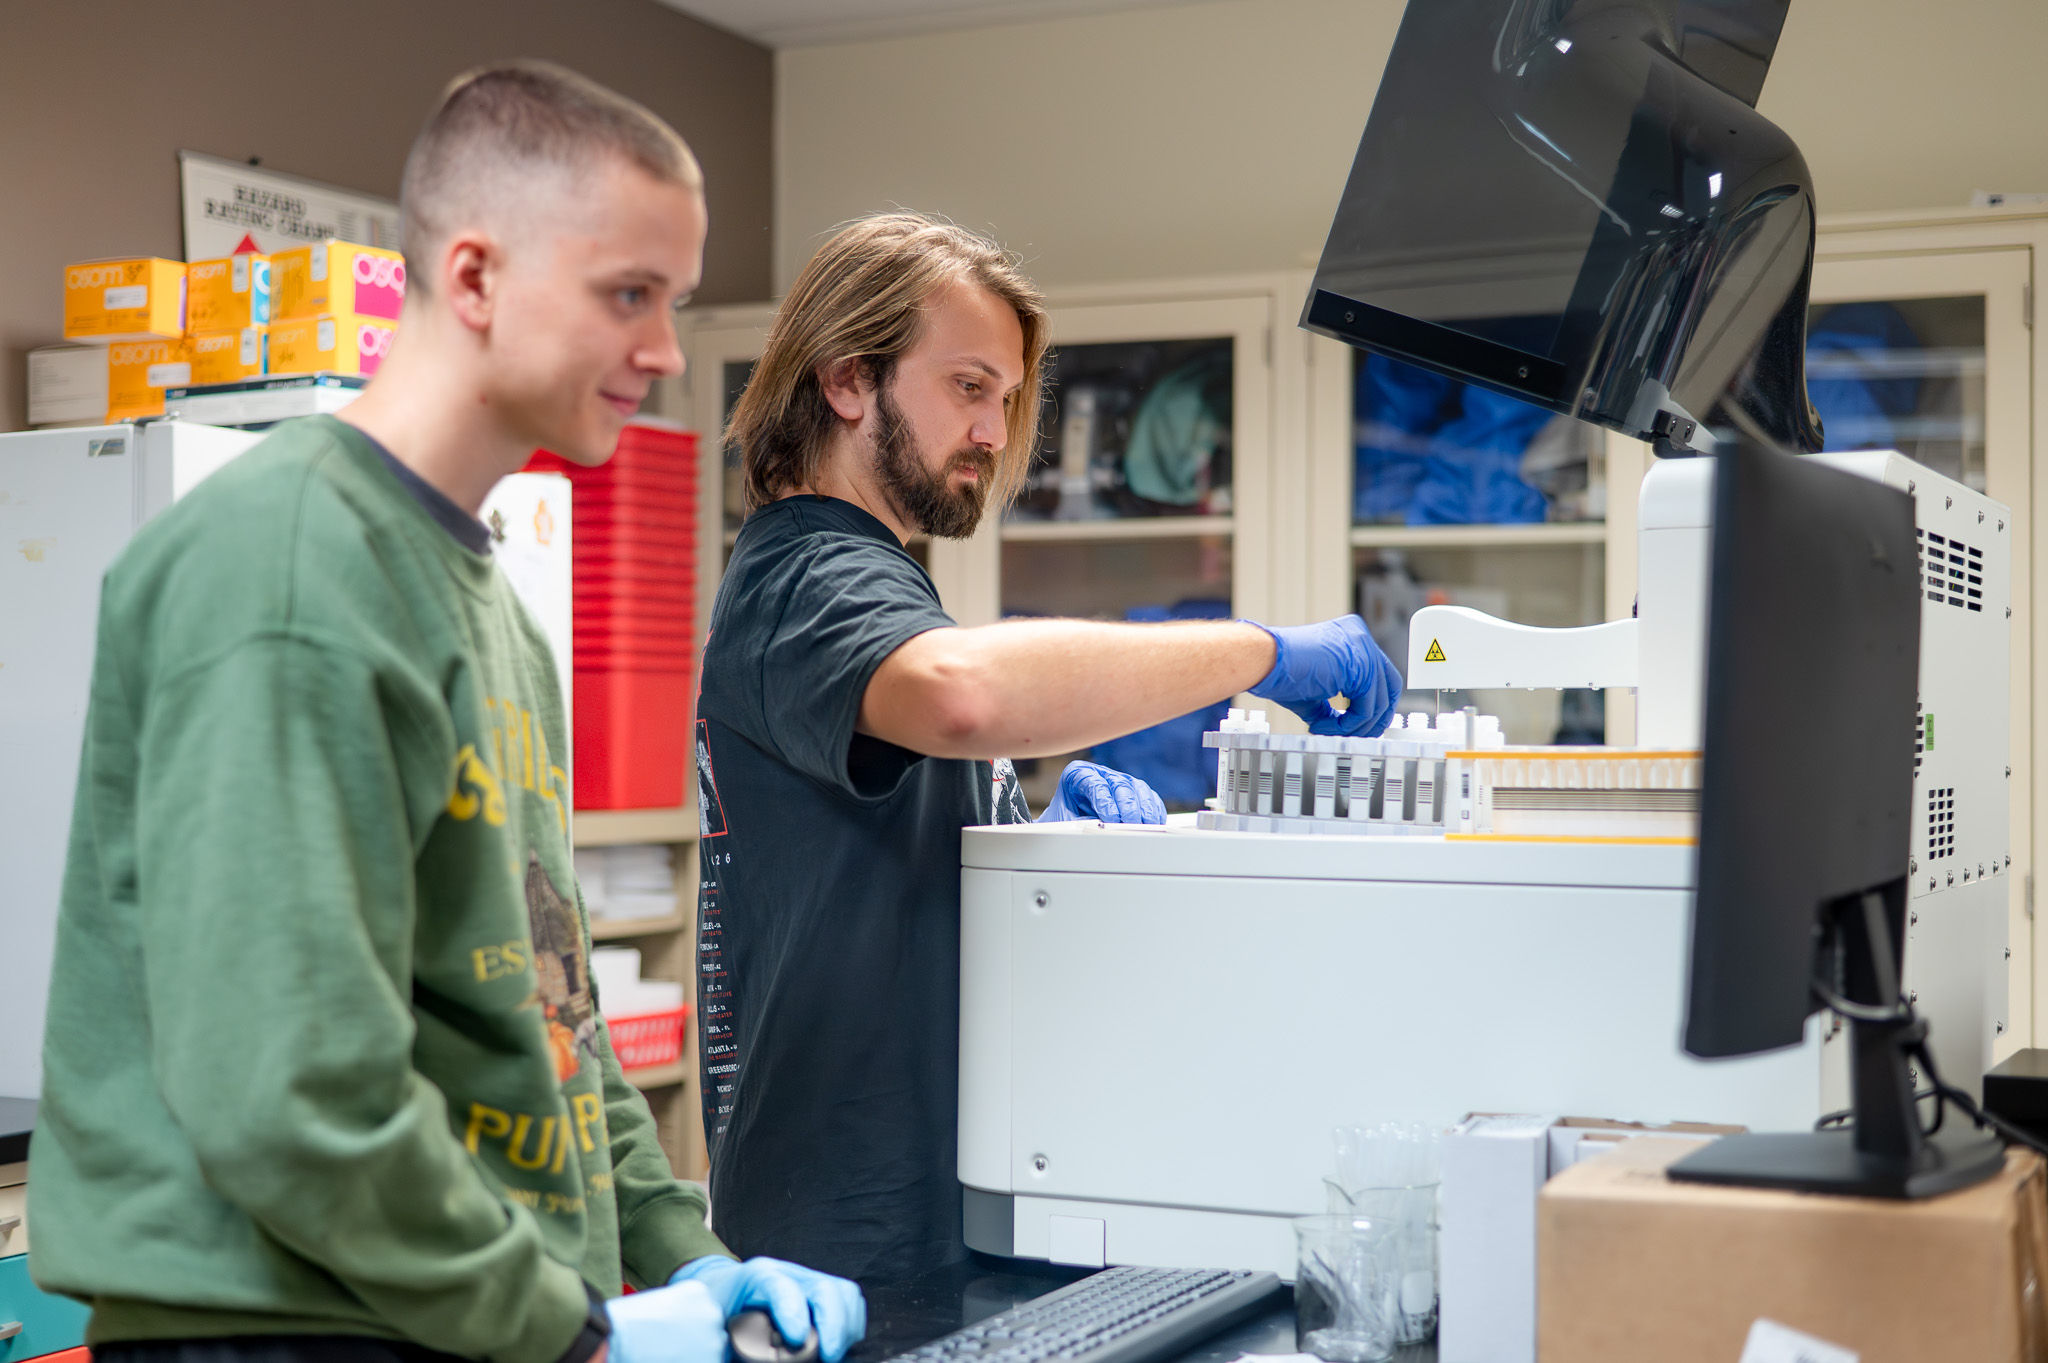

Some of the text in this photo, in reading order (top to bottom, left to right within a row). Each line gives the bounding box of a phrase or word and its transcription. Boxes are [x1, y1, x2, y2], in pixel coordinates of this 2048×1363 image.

[352, 253, 406, 295] oso
[707, 1045, 730, 1054] ATLANTA
[707, 1064, 737, 1075] GREENSBORO
